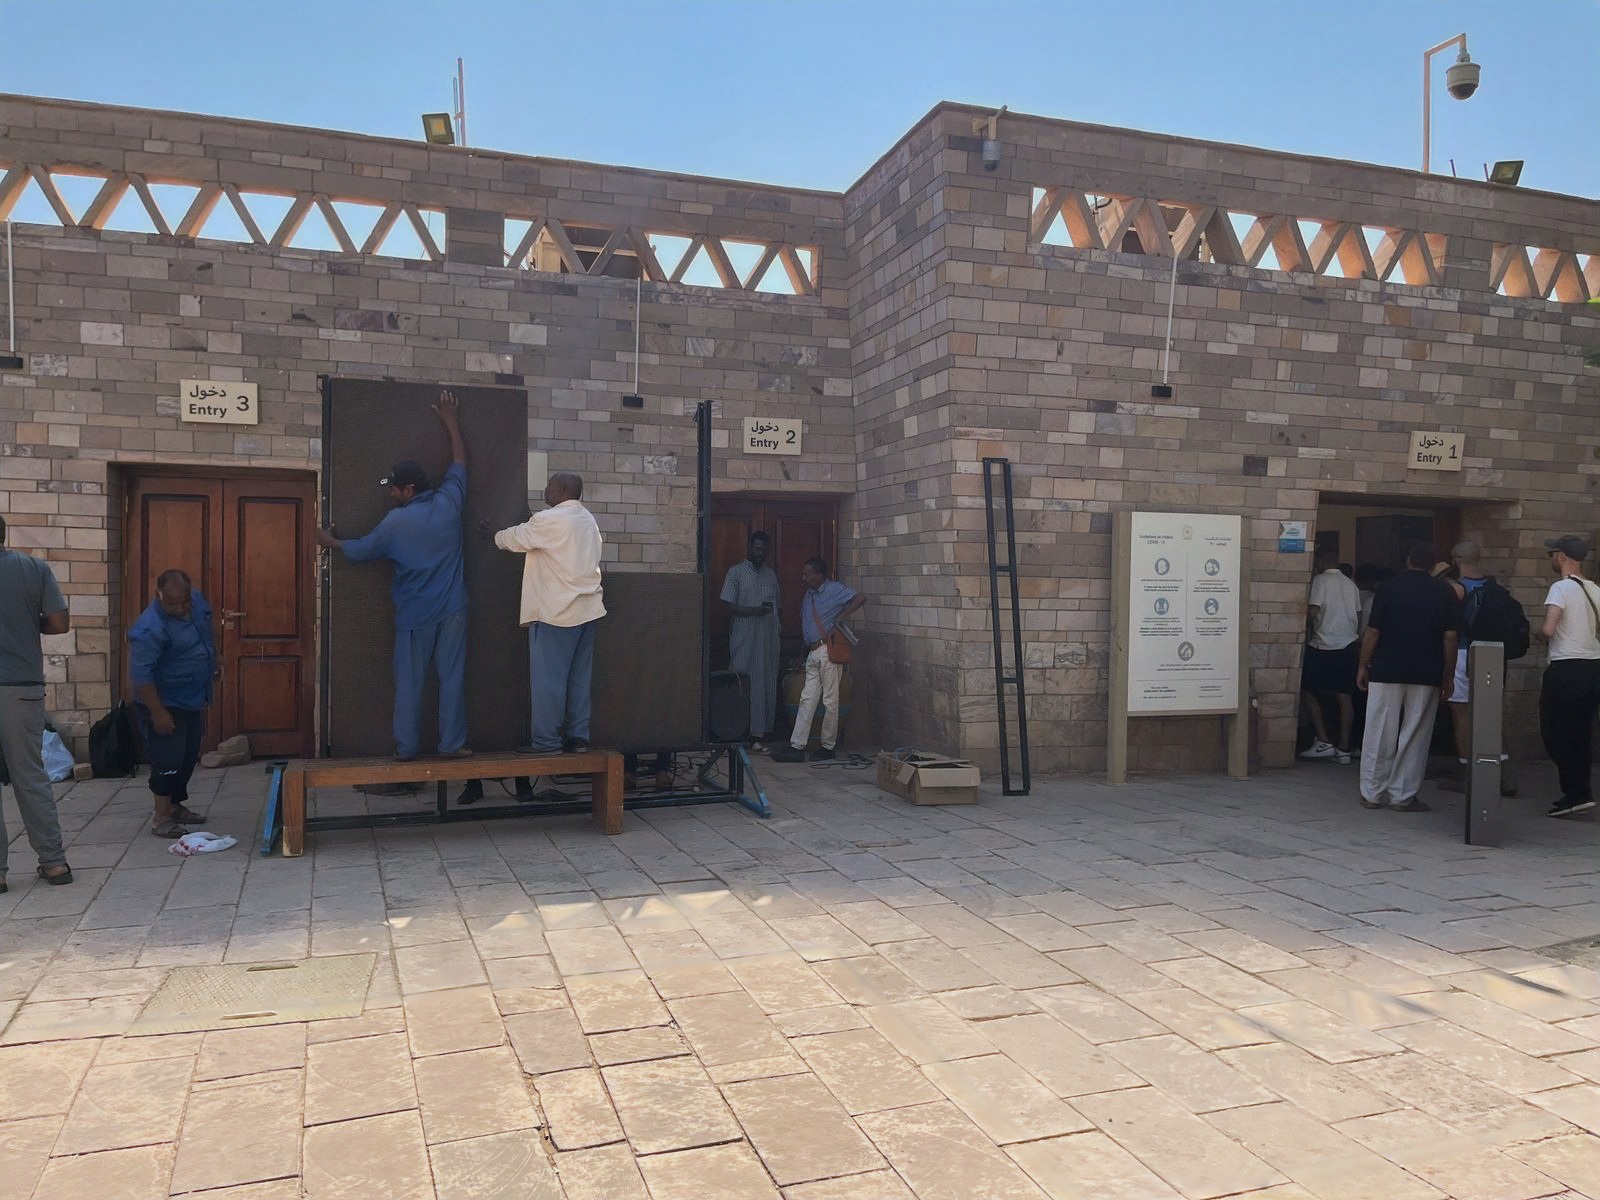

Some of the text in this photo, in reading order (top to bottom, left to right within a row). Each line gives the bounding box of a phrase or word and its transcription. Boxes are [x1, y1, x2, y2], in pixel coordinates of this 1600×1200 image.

[189, 384, 227, 400] دخول
[189, 395, 250, 418] Entry 3
[751, 421, 779, 434] دخول
[750, 429, 796, 450] Entry 2
[1419, 435, 1444, 449] دخول
[1416, 444, 1458, 465] Entry 1
